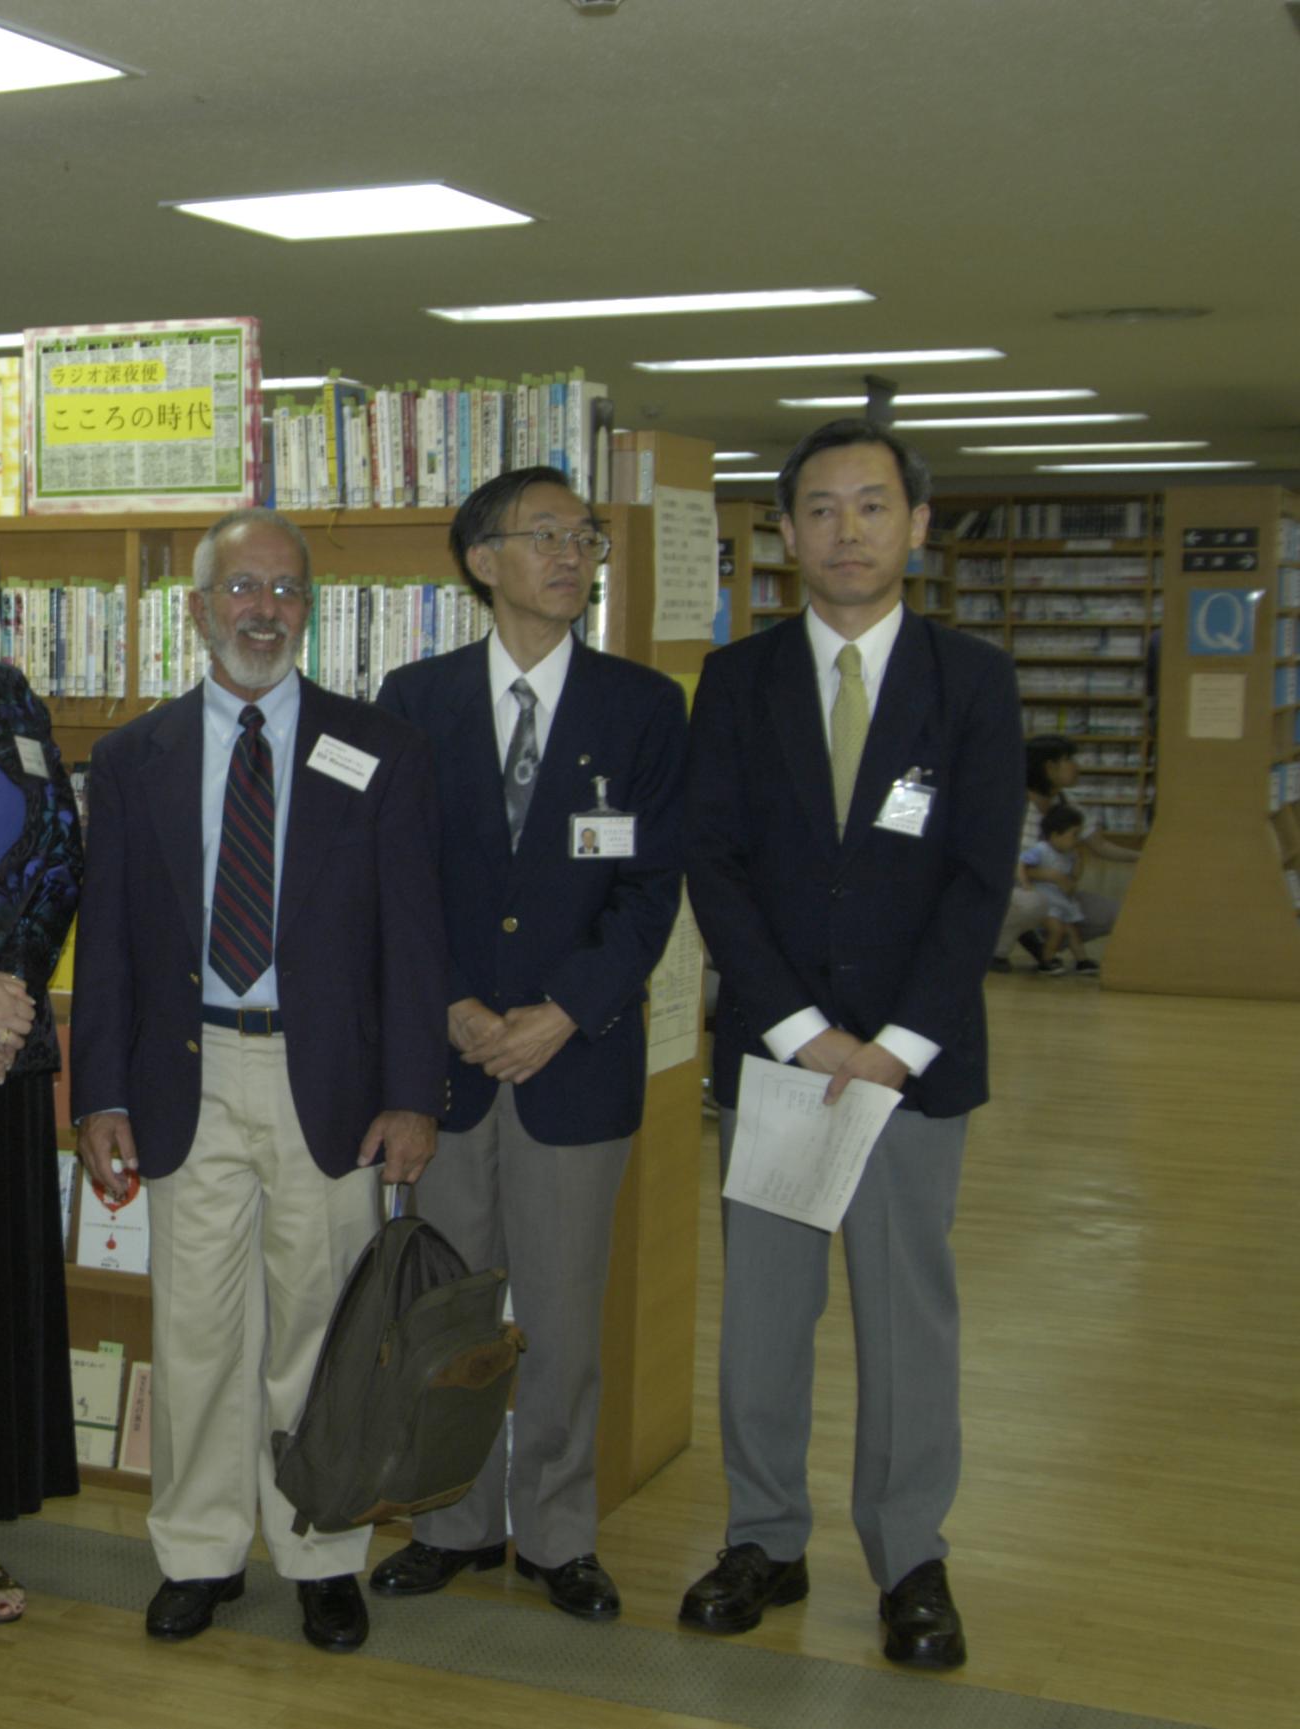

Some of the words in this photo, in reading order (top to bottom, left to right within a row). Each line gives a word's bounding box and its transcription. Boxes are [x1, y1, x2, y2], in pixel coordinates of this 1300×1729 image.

[52, 362, 159, 384] ラジオ深夜便
[52, 401, 212, 431] こころの時代
[1196, 592, 1244, 651] Q
